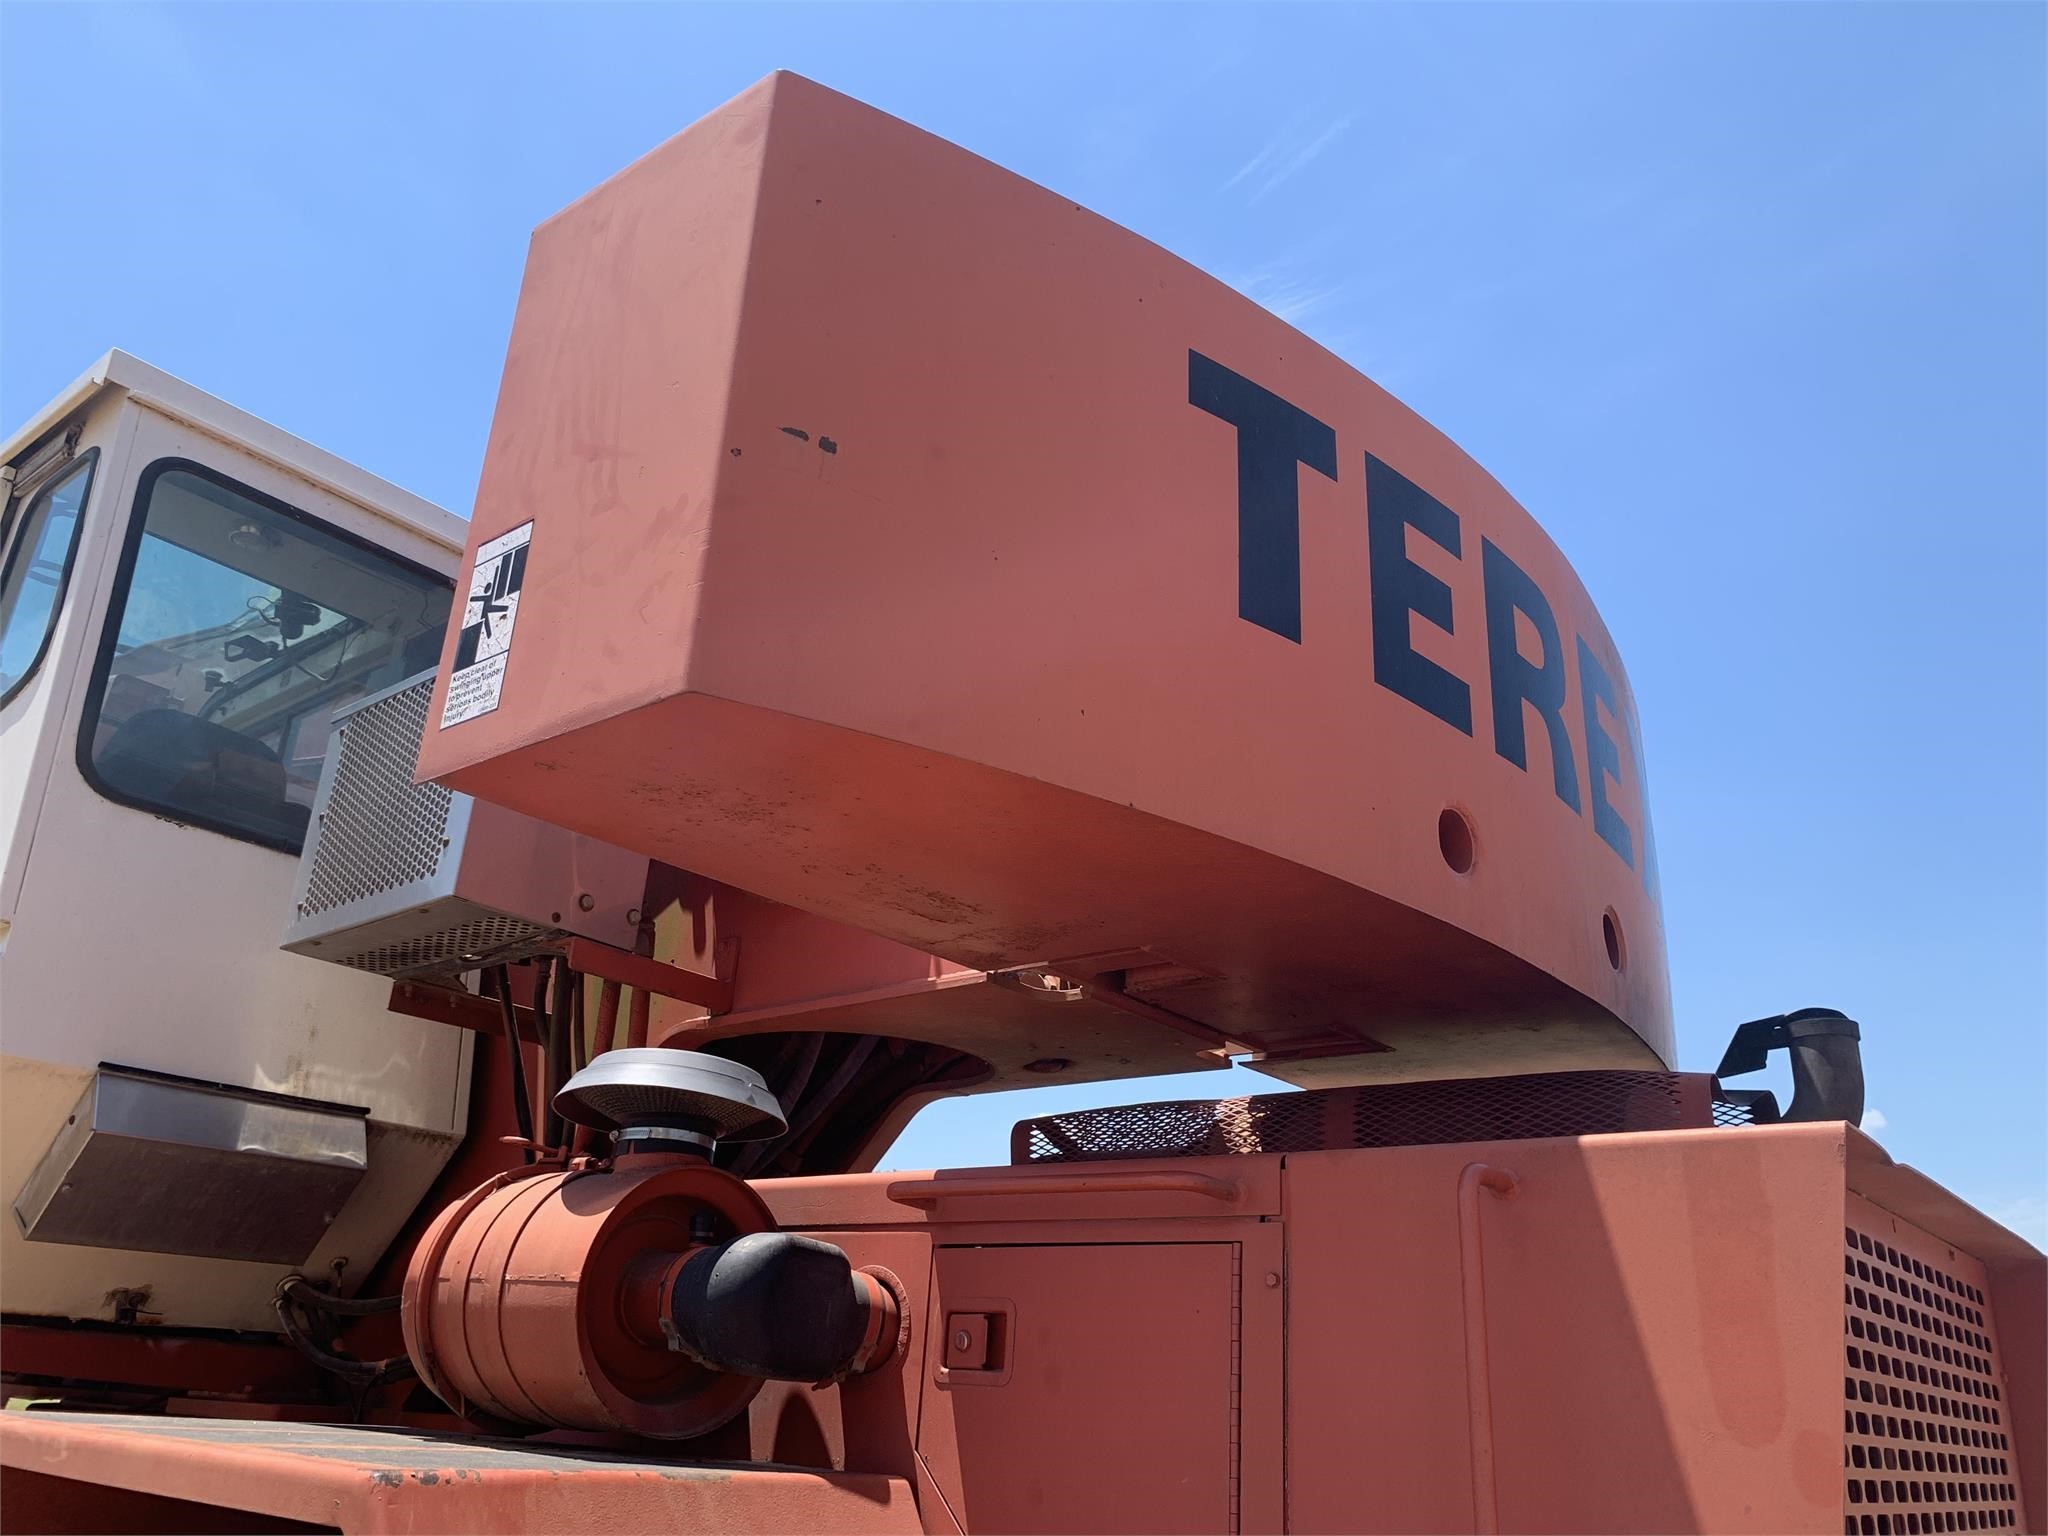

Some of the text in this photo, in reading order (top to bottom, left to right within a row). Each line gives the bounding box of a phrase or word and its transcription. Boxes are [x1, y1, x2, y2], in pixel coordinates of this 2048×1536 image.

[450, 667, 503, 692] swinging upper
[453, 671, 470, 683] Keep
[470, 665, 488, 676] clear
[446, 698, 472, 712] serious
[473, 689, 495, 702] bodily
[455, 685, 482, 701] prevent
